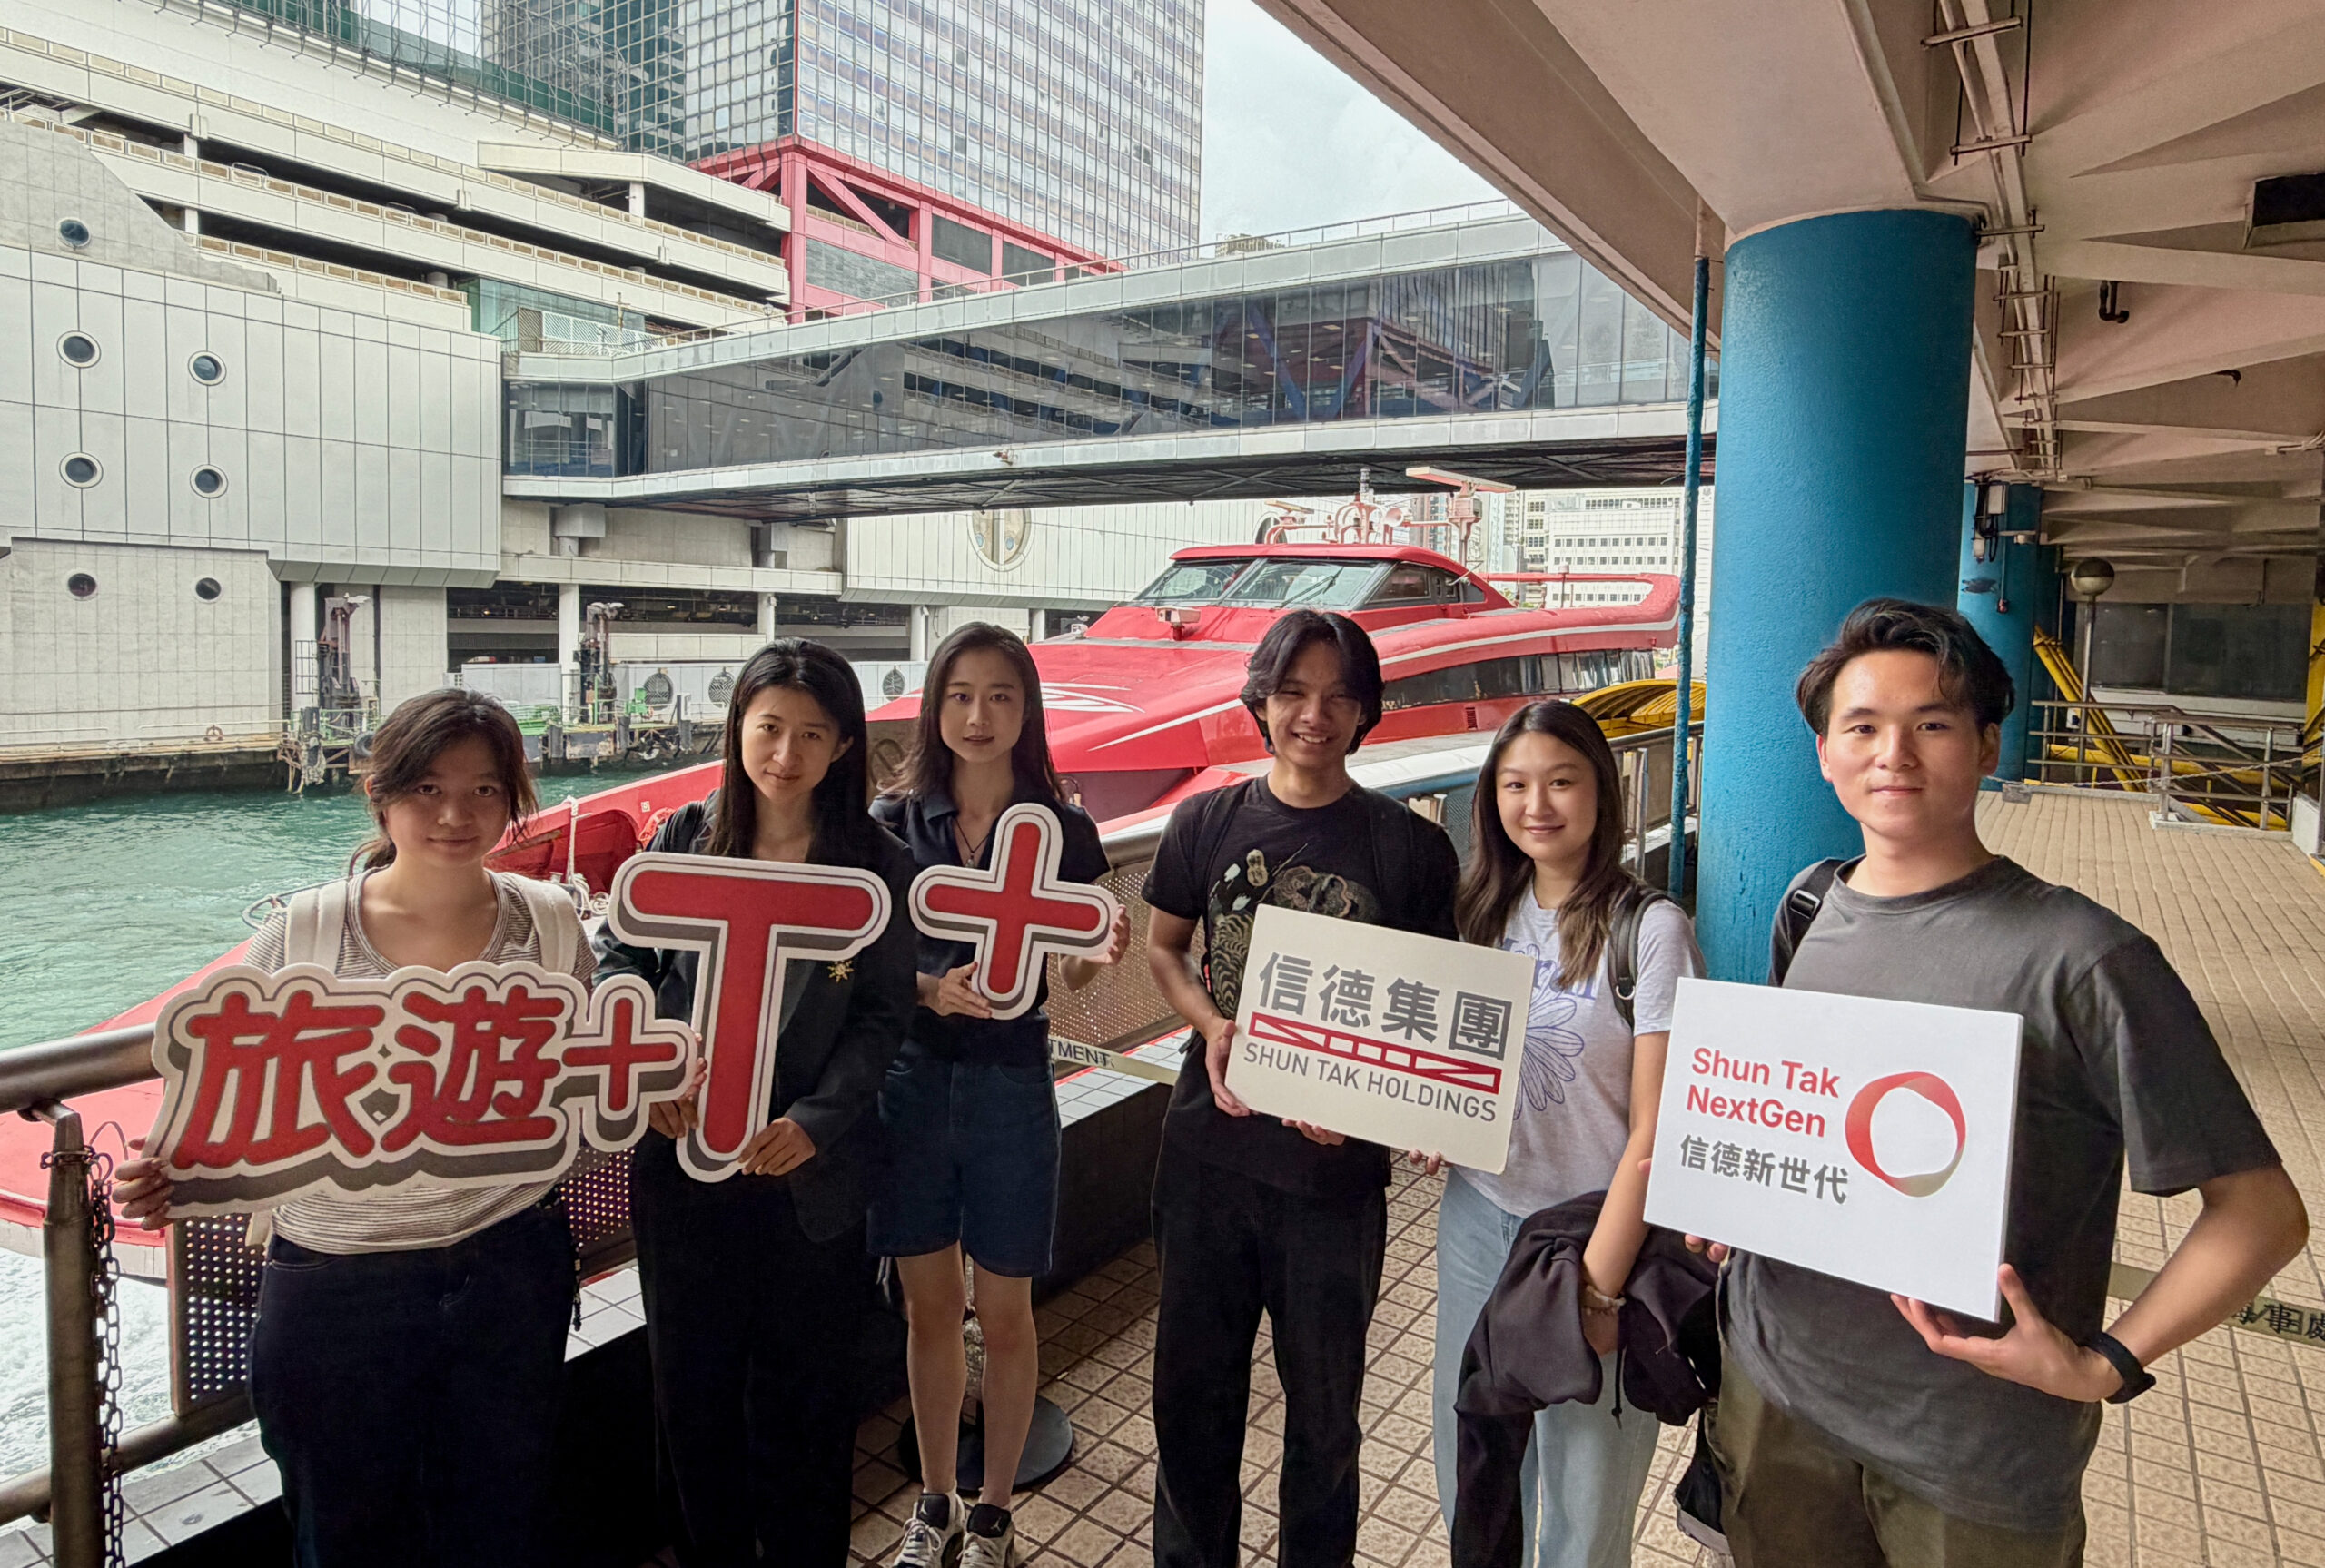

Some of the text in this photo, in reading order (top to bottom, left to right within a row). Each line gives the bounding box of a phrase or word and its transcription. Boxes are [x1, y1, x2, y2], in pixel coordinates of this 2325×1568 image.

[630, 870, 874, 1153] T
[1259, 952, 1513, 1061] 信德集團
[1243, 1042, 1497, 1122] SHUN TAK HOLDINGS
[1687, 1084, 1826, 1138] NextGen
[1691, 1047, 1841, 1099] Shun Tak
[1679, 1133, 1849, 1205] 信德新世代
